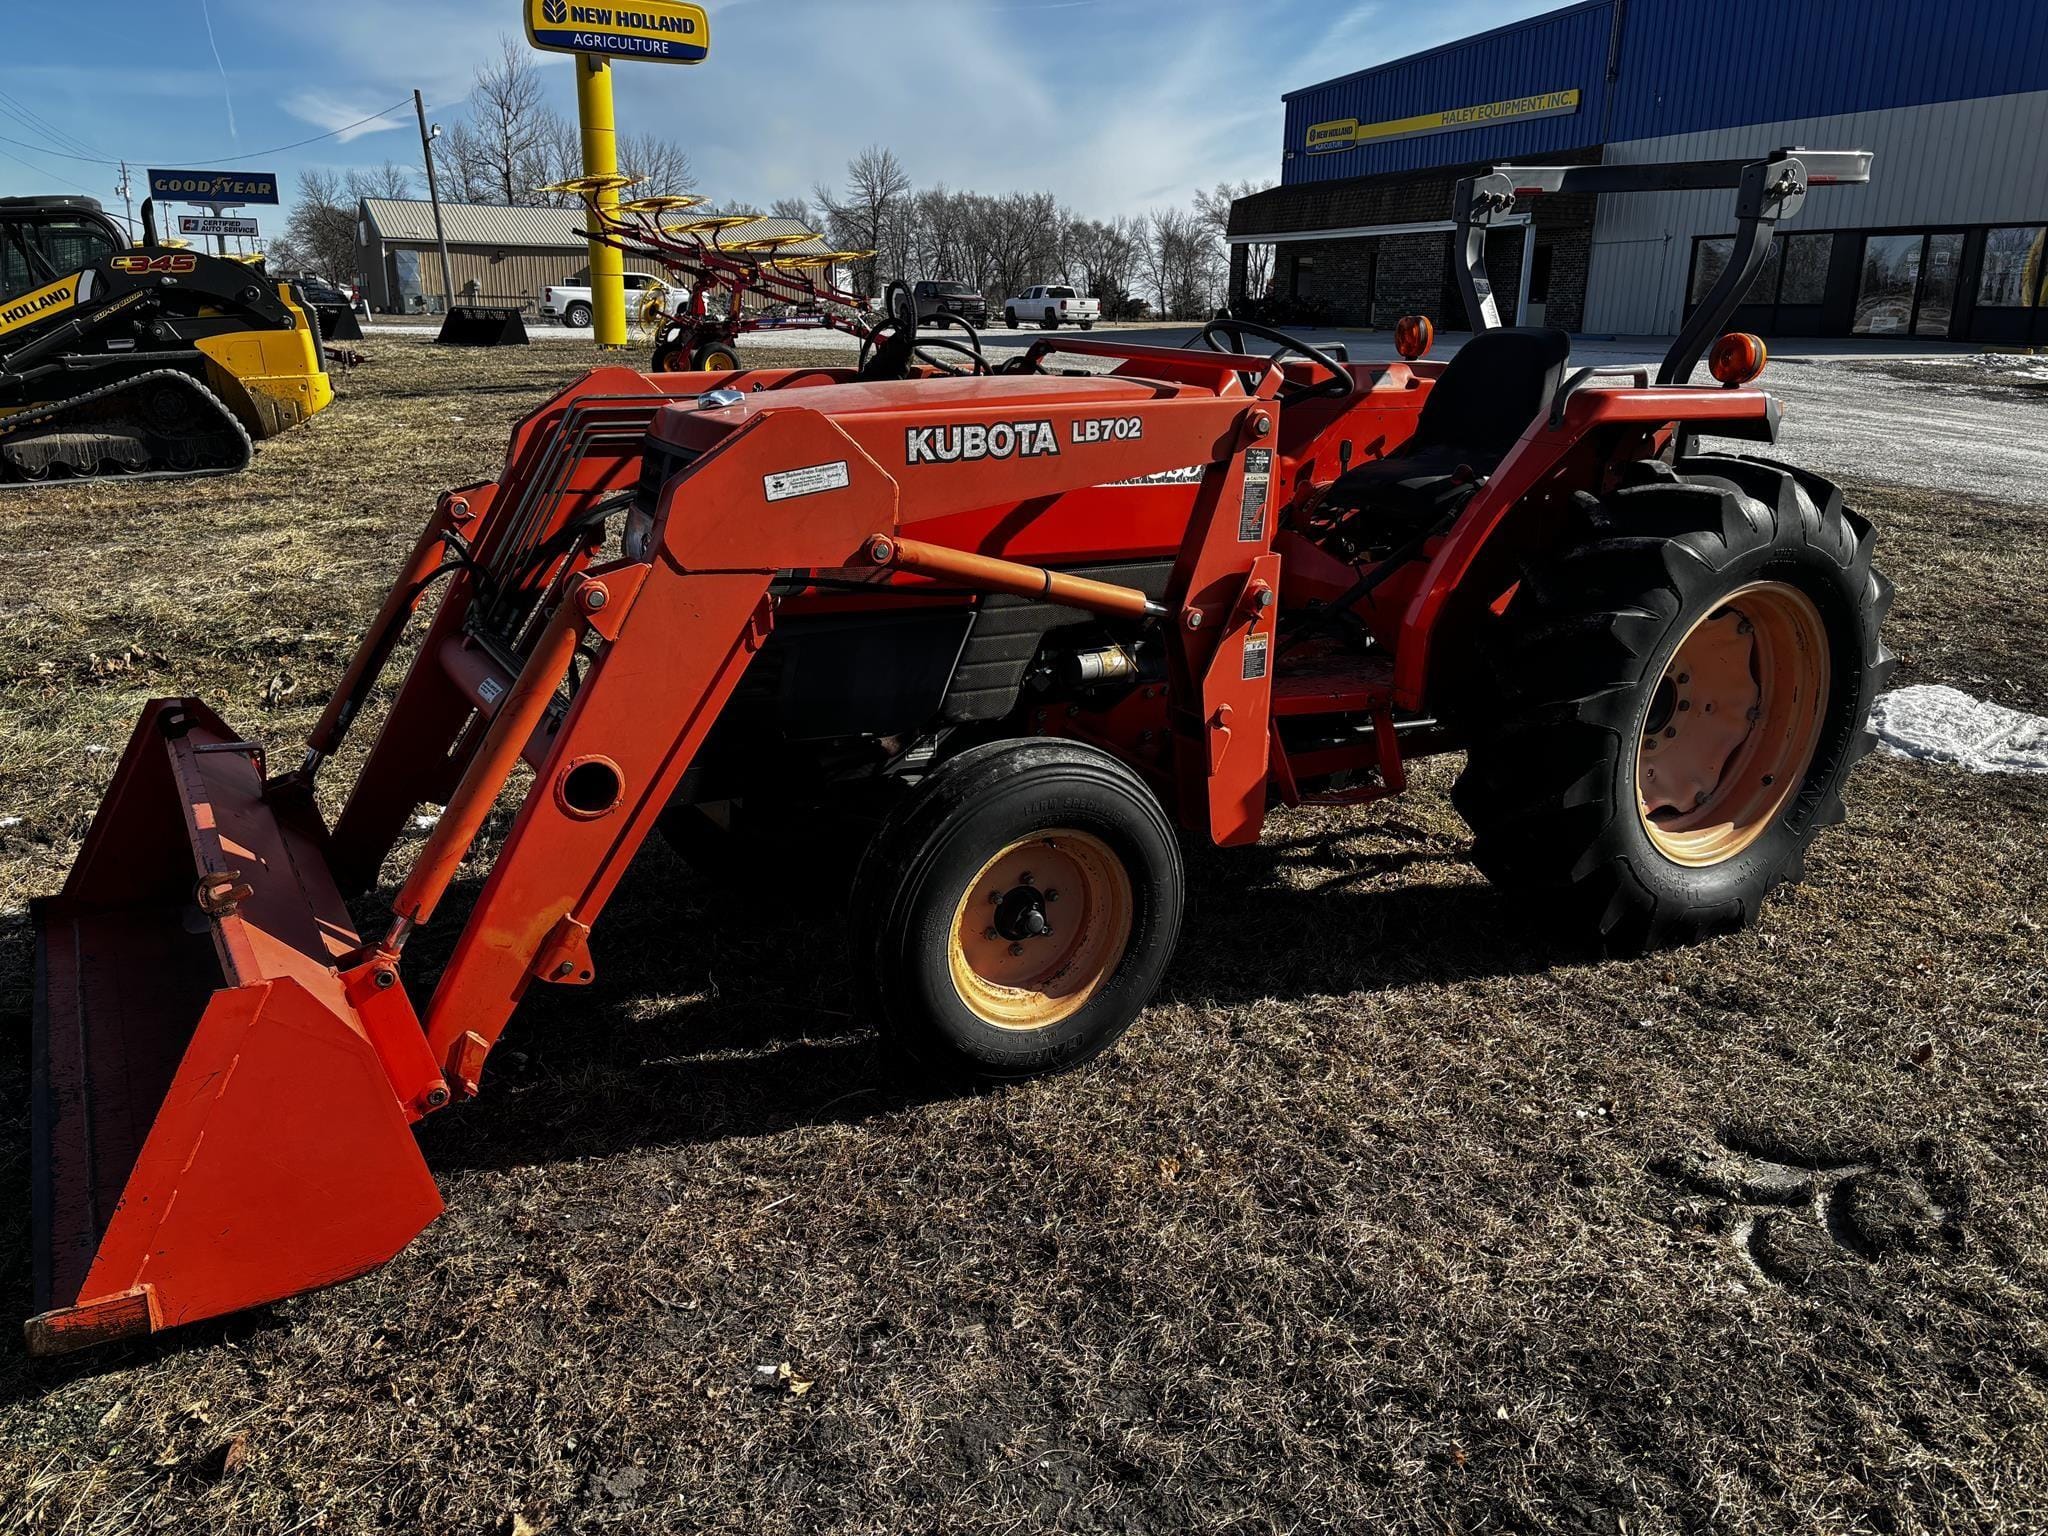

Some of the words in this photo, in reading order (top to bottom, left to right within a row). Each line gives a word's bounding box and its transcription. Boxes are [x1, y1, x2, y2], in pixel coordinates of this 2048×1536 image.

[571, 6, 612, 26] NEW
[616, 11, 695, 34] HOLLAND
[573, 33, 669, 54] AGRICULTURE
[1441, 108, 1476, 125] HALEY
[1547, 92, 1573, 107] INC.
[1316, 130, 1328, 139] NEW
[1328, 126, 1353, 137] HOLLAND
[203, 219, 241, 227] CERTIFIED
[224, 226, 255, 234] SERVICE
[1, 287, 71, 324] HOLLAND
[907, 420, 1059, 463] KUBOTA
[1072, 417, 1142, 442] LB702
[957, 1032, 1085, 1066] CARLISLE
